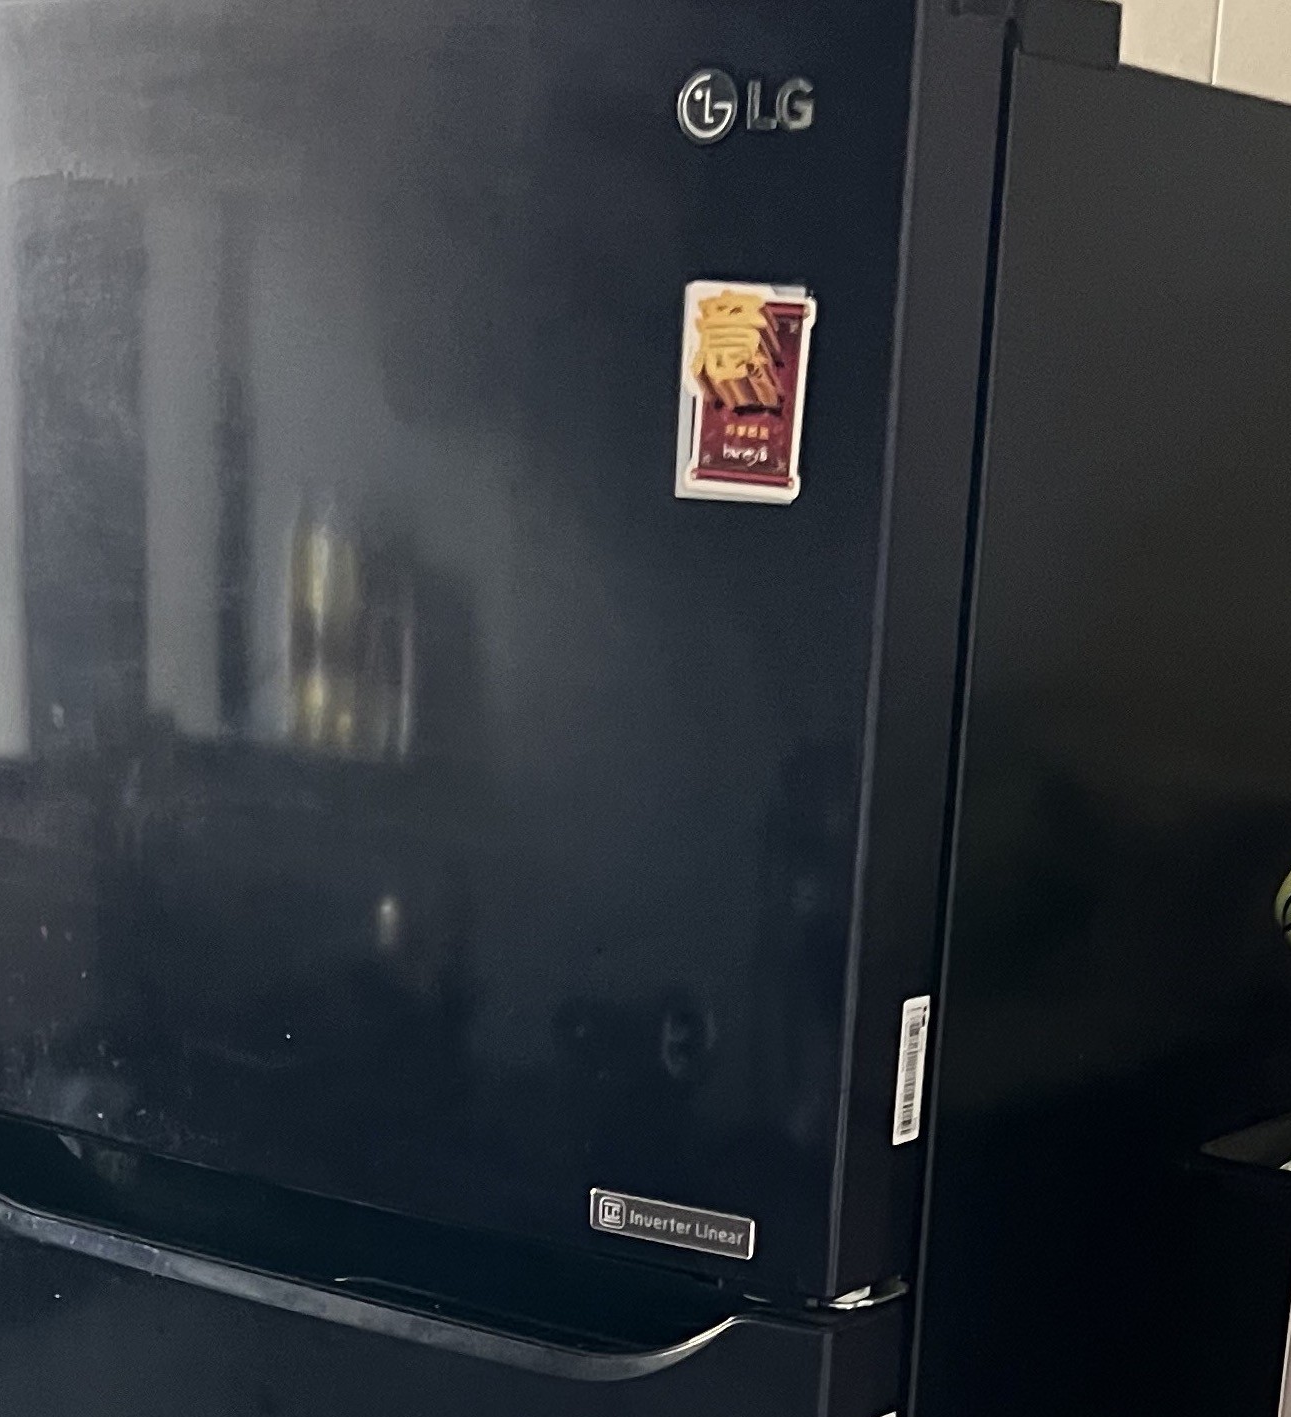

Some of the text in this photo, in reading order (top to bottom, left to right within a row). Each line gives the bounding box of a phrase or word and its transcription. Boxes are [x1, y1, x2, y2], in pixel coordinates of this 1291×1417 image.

[745, 77, 815, 131] LG
[629, 1209, 745, 1246] Inverter Linear
